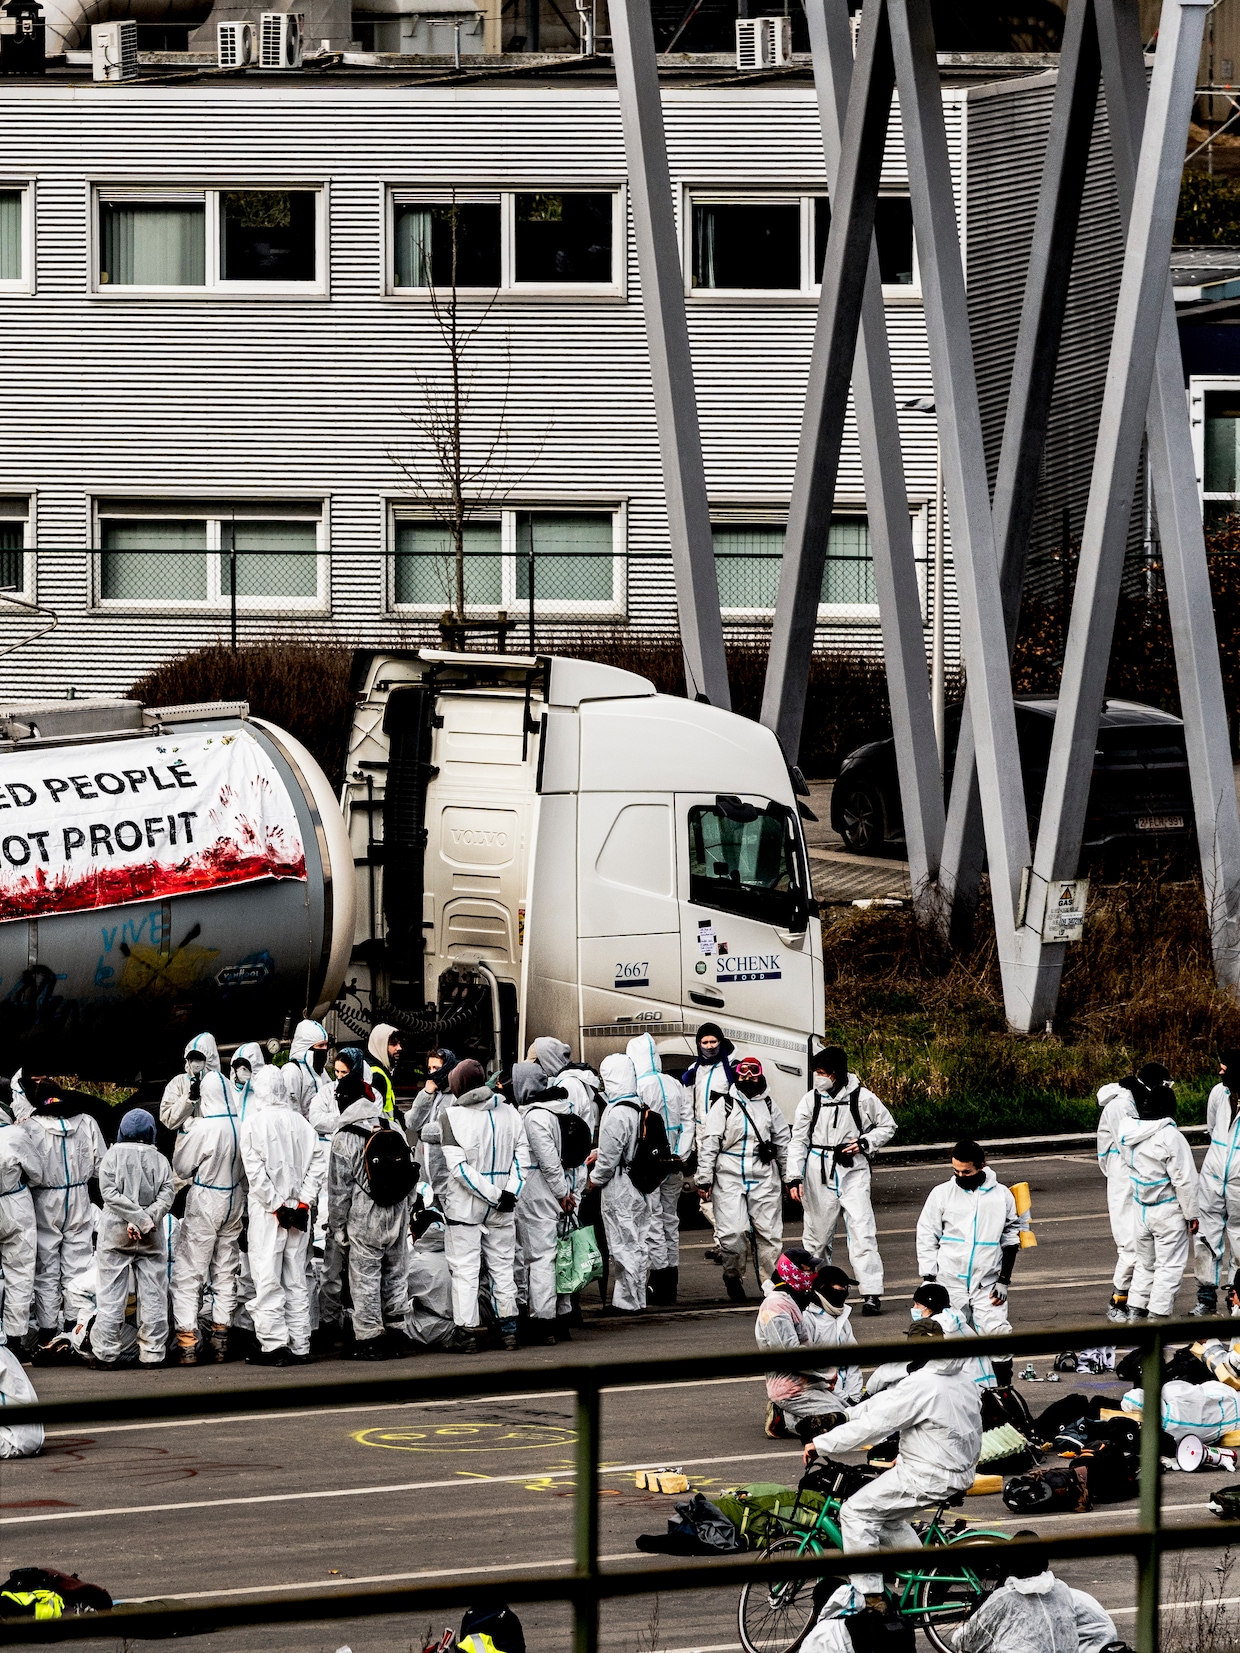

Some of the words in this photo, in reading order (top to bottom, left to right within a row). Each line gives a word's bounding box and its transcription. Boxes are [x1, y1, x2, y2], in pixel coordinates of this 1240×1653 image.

[43, 763, 197, 802] PEOPLE
[63, 811, 198, 860] PROFIT
[450, 828, 508, 847] VOLVO
[101, 909, 170, 953] VIVE
[615, 962, 649, 978] 2667
[716, 954, 781, 972] SCHENK
[734, 973, 765, 981] FOOD
[635, 1011, 663, 1021] 460
